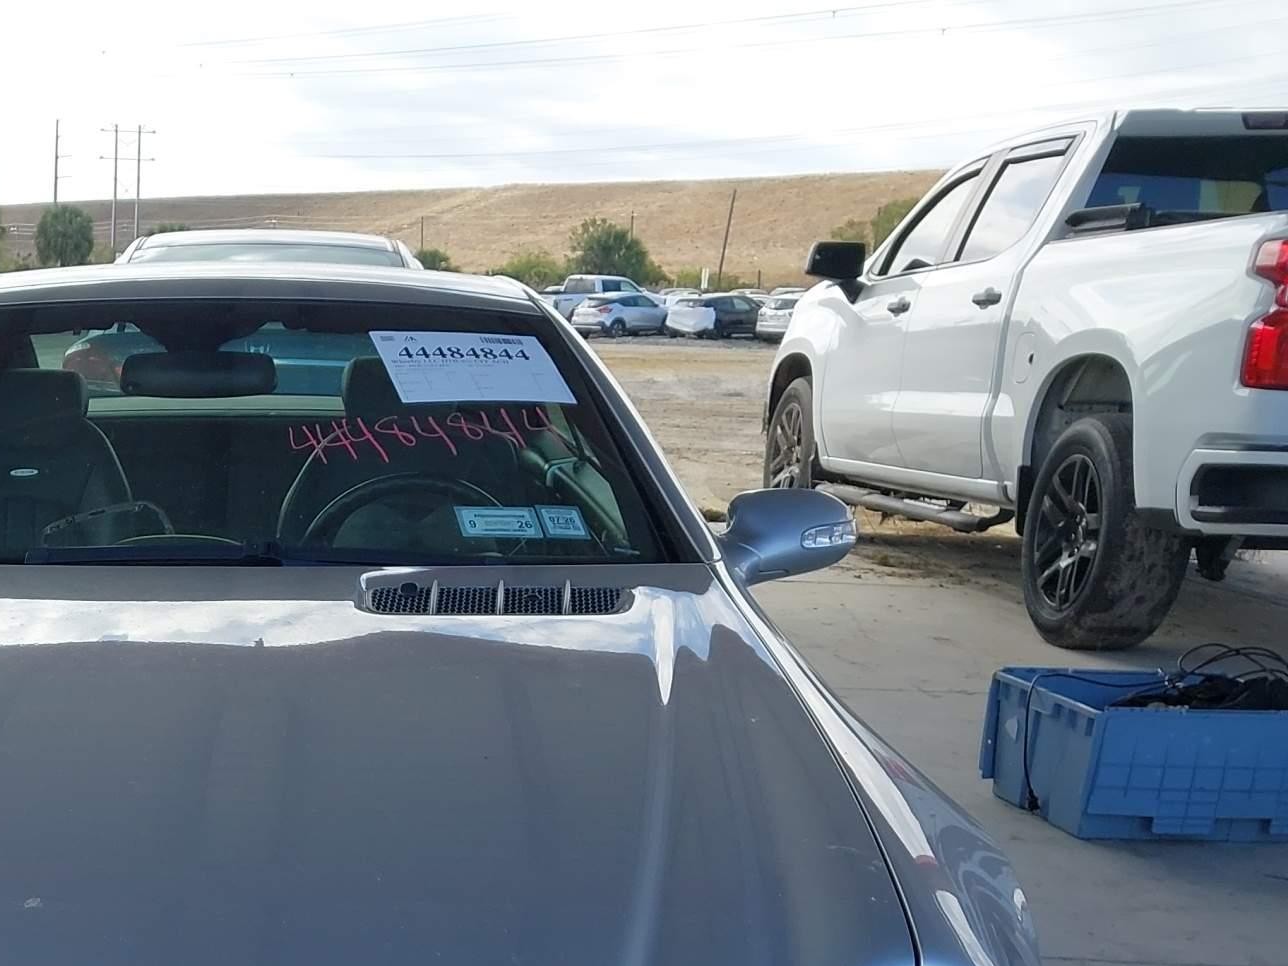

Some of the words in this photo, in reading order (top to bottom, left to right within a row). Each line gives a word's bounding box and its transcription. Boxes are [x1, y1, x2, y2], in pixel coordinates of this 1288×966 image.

[398, 346, 531, 361] 44484844
[289, 407, 576, 464] 44484844
[516, 520, 533, 529] 26
